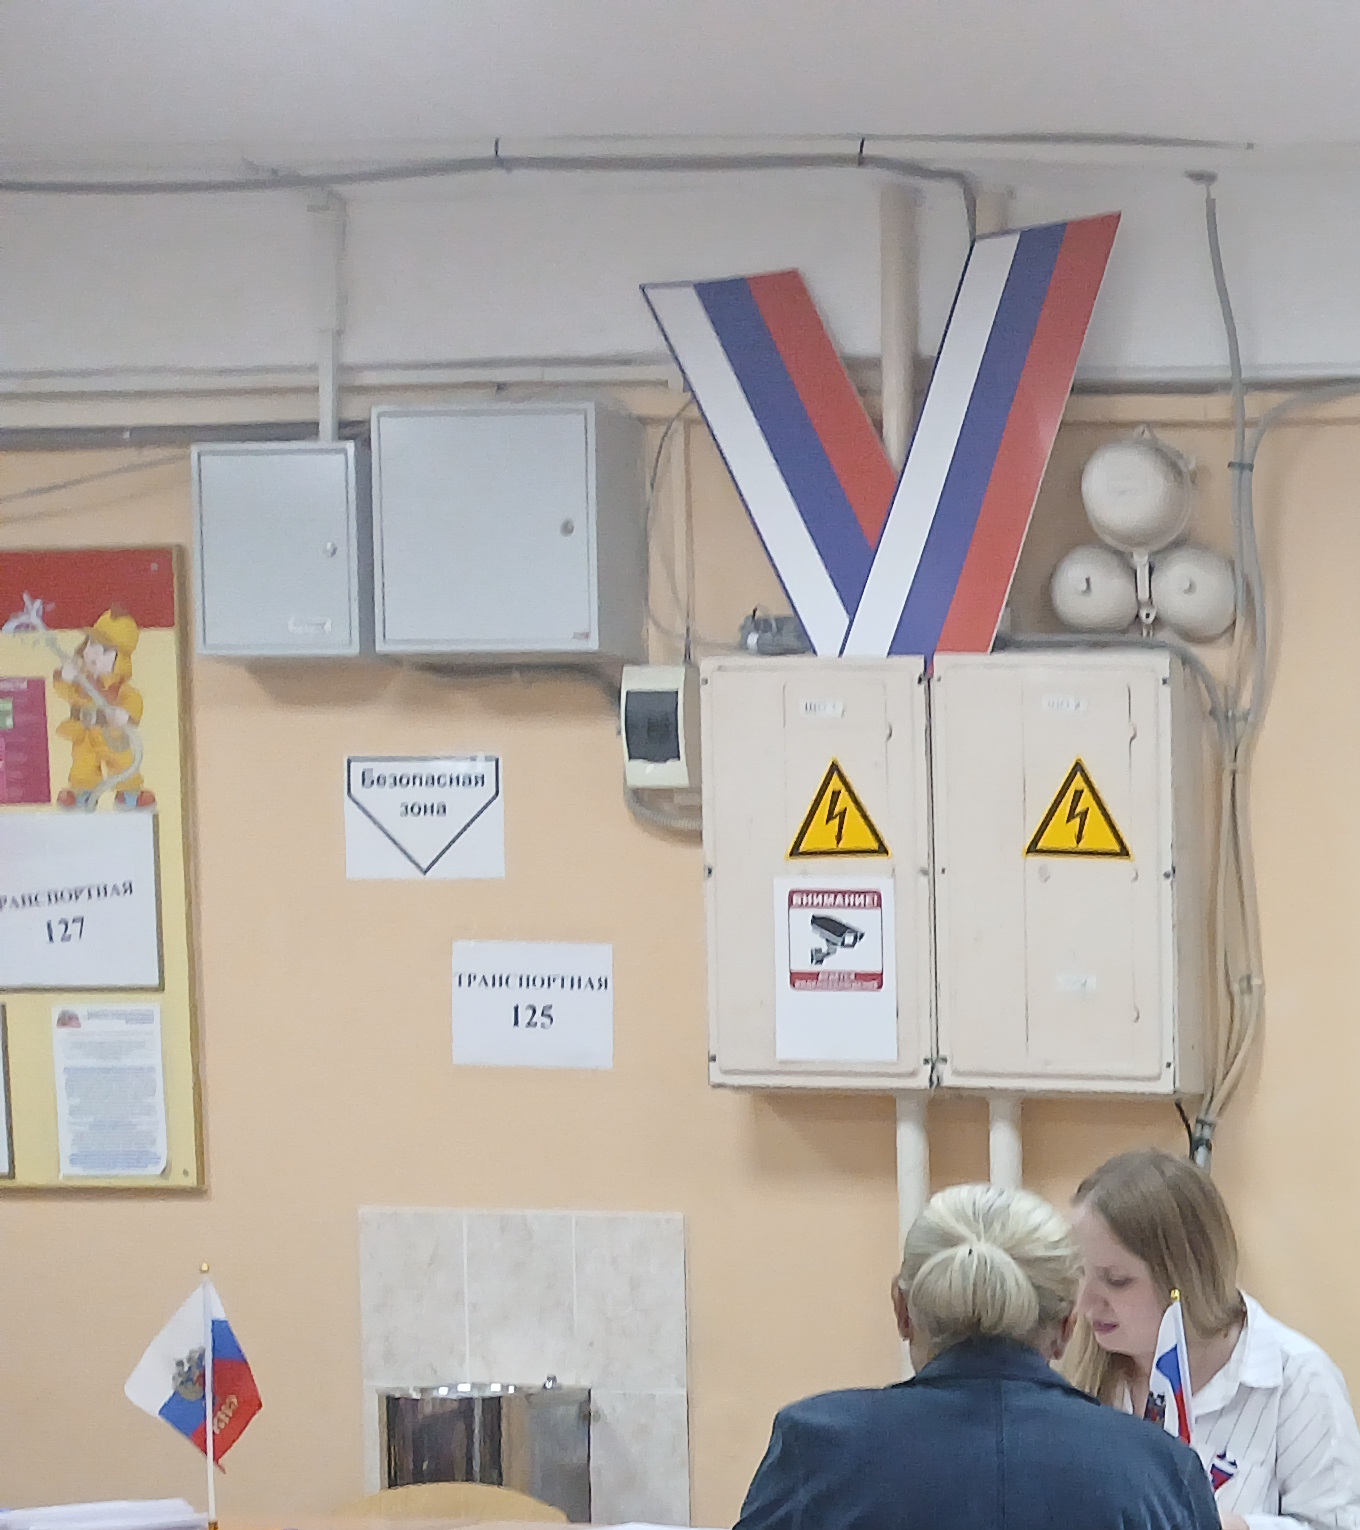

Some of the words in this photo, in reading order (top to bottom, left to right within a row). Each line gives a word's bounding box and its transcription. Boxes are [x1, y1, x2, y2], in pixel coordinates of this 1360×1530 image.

[361, 768, 485, 789] Безопасная
[400, 801, 447, 818] зона
[792, 892, 878, 908] ВНИМАНИЕ!
[46, 915, 85, 944] 127
[455, 972, 609, 991] ТРАНСПОРТНАЯ
[512, 1003, 555, 1029] 125
